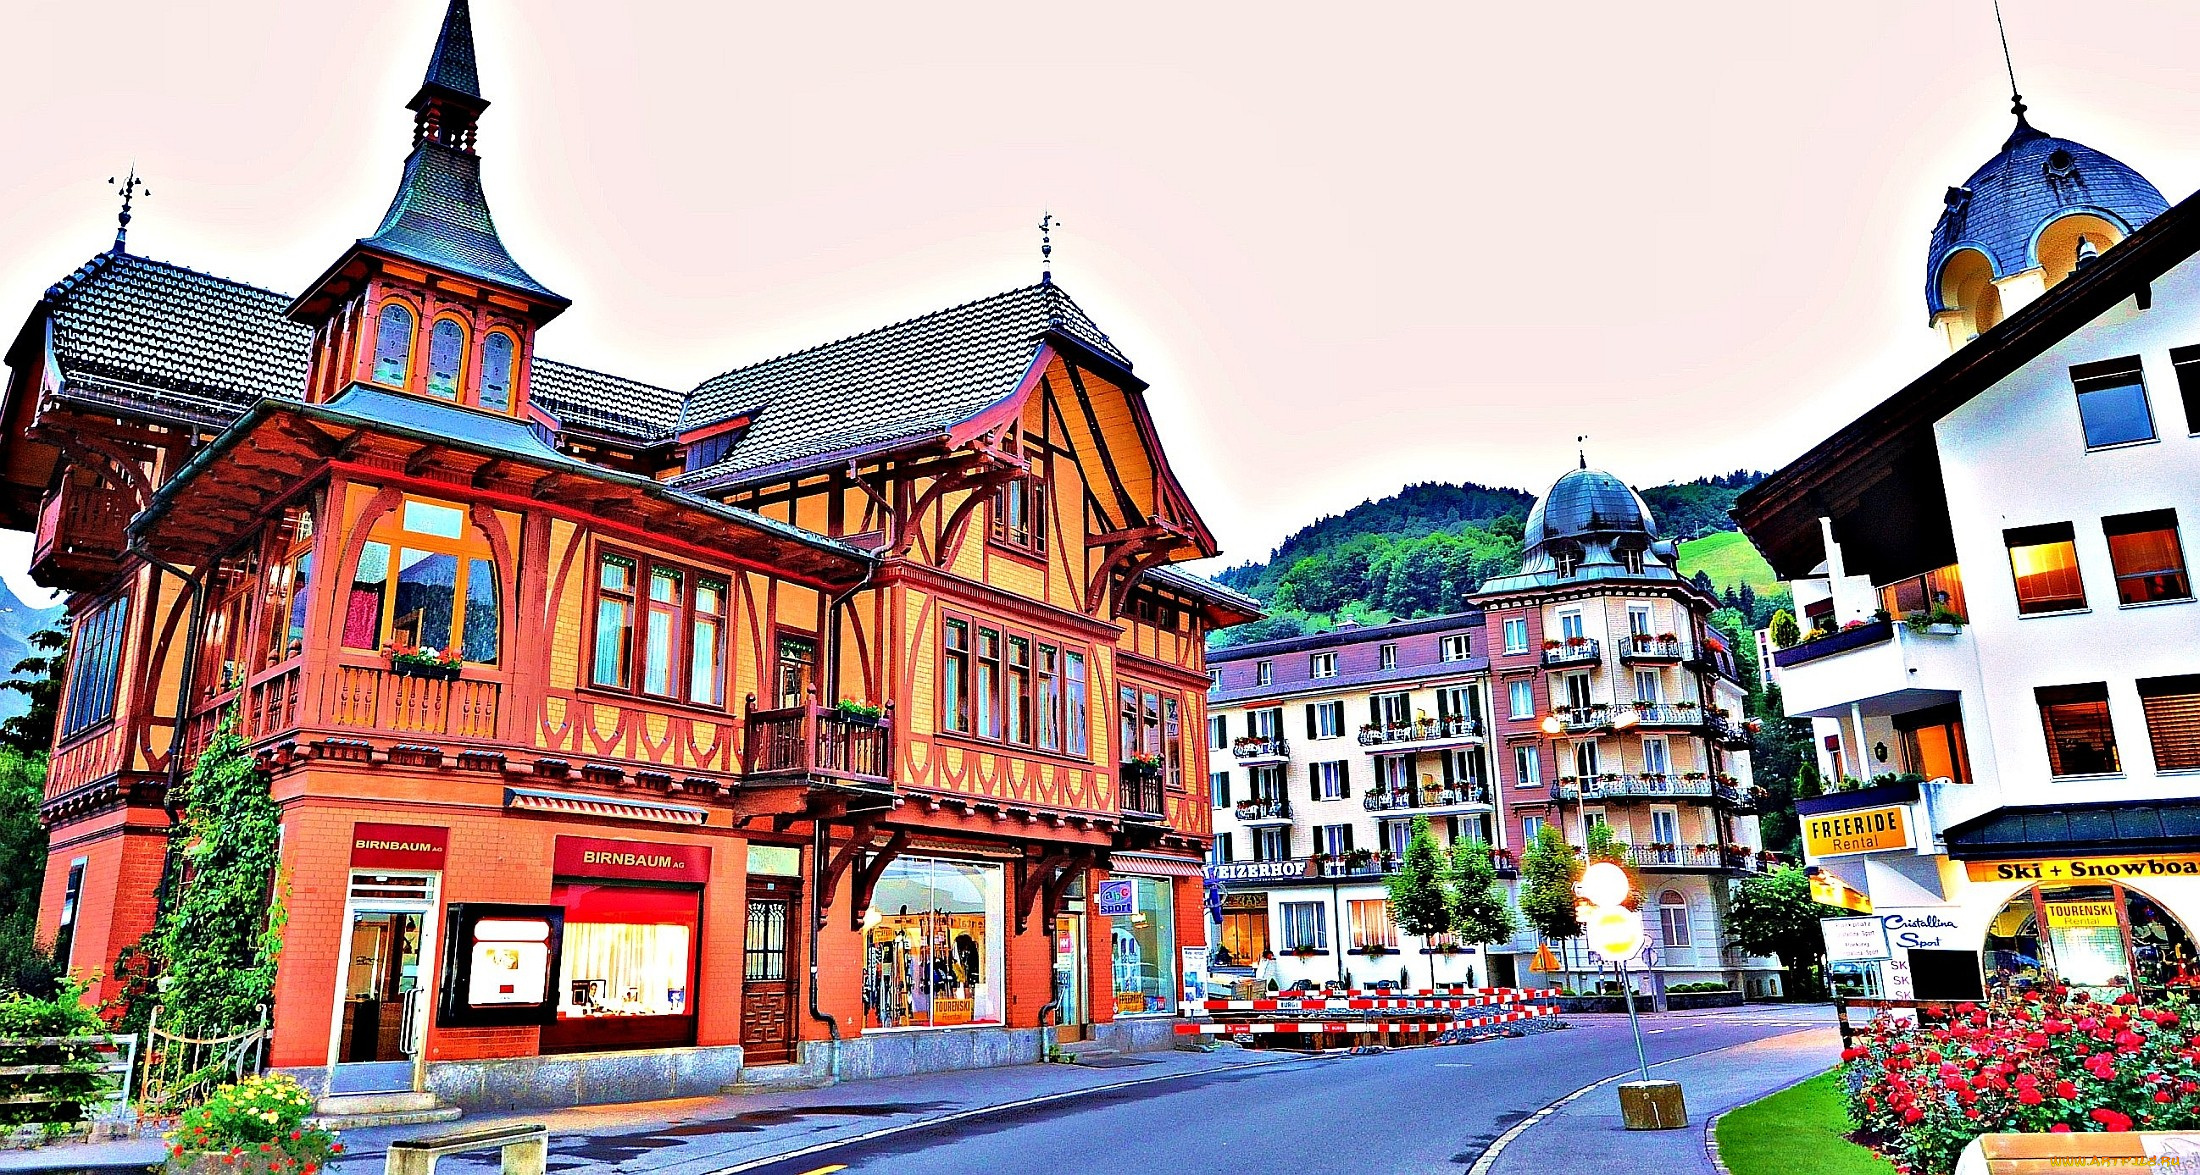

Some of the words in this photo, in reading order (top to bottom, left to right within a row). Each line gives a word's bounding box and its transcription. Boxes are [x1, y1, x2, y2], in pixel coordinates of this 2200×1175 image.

[1812, 812, 1897, 839] FREERIDE
[355, 839, 432, 852] BIRNBAUM
[1833, 835, 1879, 851] Rental
[583, 850, 672, 868] BIRNBAUM
[1997, 863, 2042, 880] Ski
[2071, 859, 2200, 878] Snowboa
[1105, 888, 1129, 902] abc
[1101, 903, 1132, 914] sport
[2049, 904, 2114, 917] TOURENSKI
[1884, 915, 1958, 930] Cristallina
[2064, 916, 2100, 926] Rental
[1896, 932, 1942, 949] Sport
[935, 1000, 970, 1013] TOURENSKI
